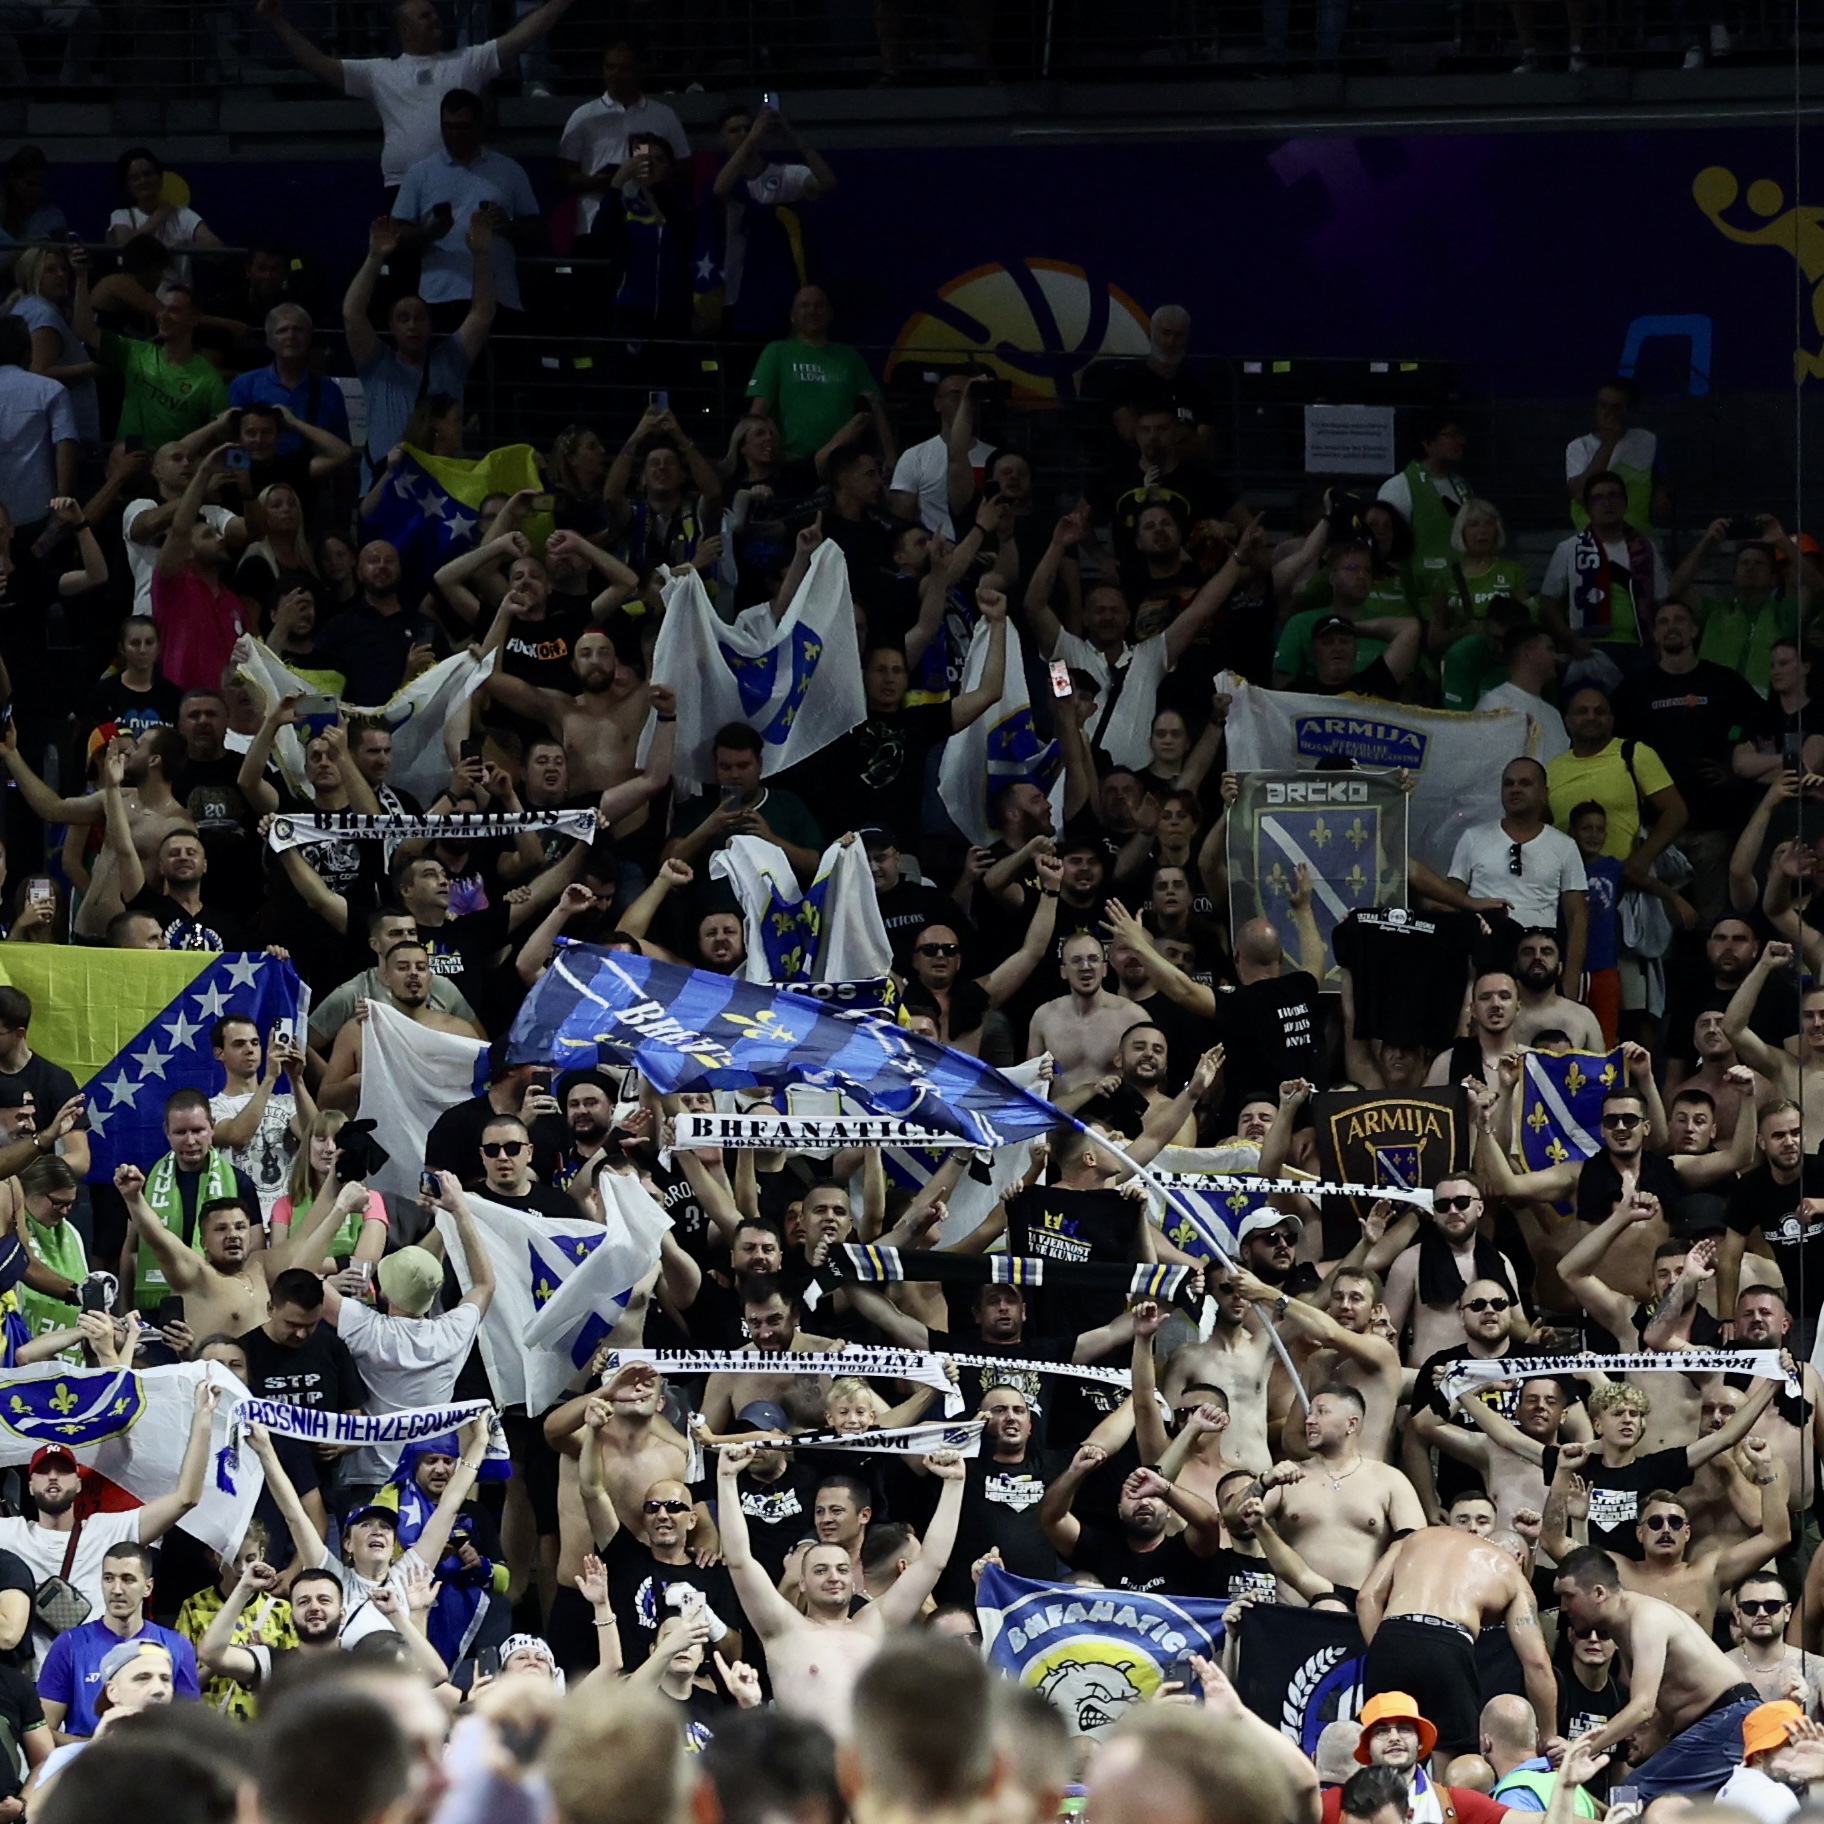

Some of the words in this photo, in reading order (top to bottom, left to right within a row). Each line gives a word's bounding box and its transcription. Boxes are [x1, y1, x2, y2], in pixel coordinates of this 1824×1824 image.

[1300, 717, 1421, 751] ARMIJA
[204, 802, 225, 818] 20
[314, 809, 562, 831] BHFANATICOS
[483, 825, 526, 836] ARMY
[692, 1116, 944, 1143] BHFANATIC
[1347, 1107, 1444, 1146] ARMIJA
[801, 1363, 834, 1372] MOJA
[264, 1373, 322, 1390] STP
[247, 1400, 329, 1440] BOSNIA
[336, 1403, 487, 1441] HERZEGOVINA
[1005, 1598, 1190, 1657] BHFANATIC
